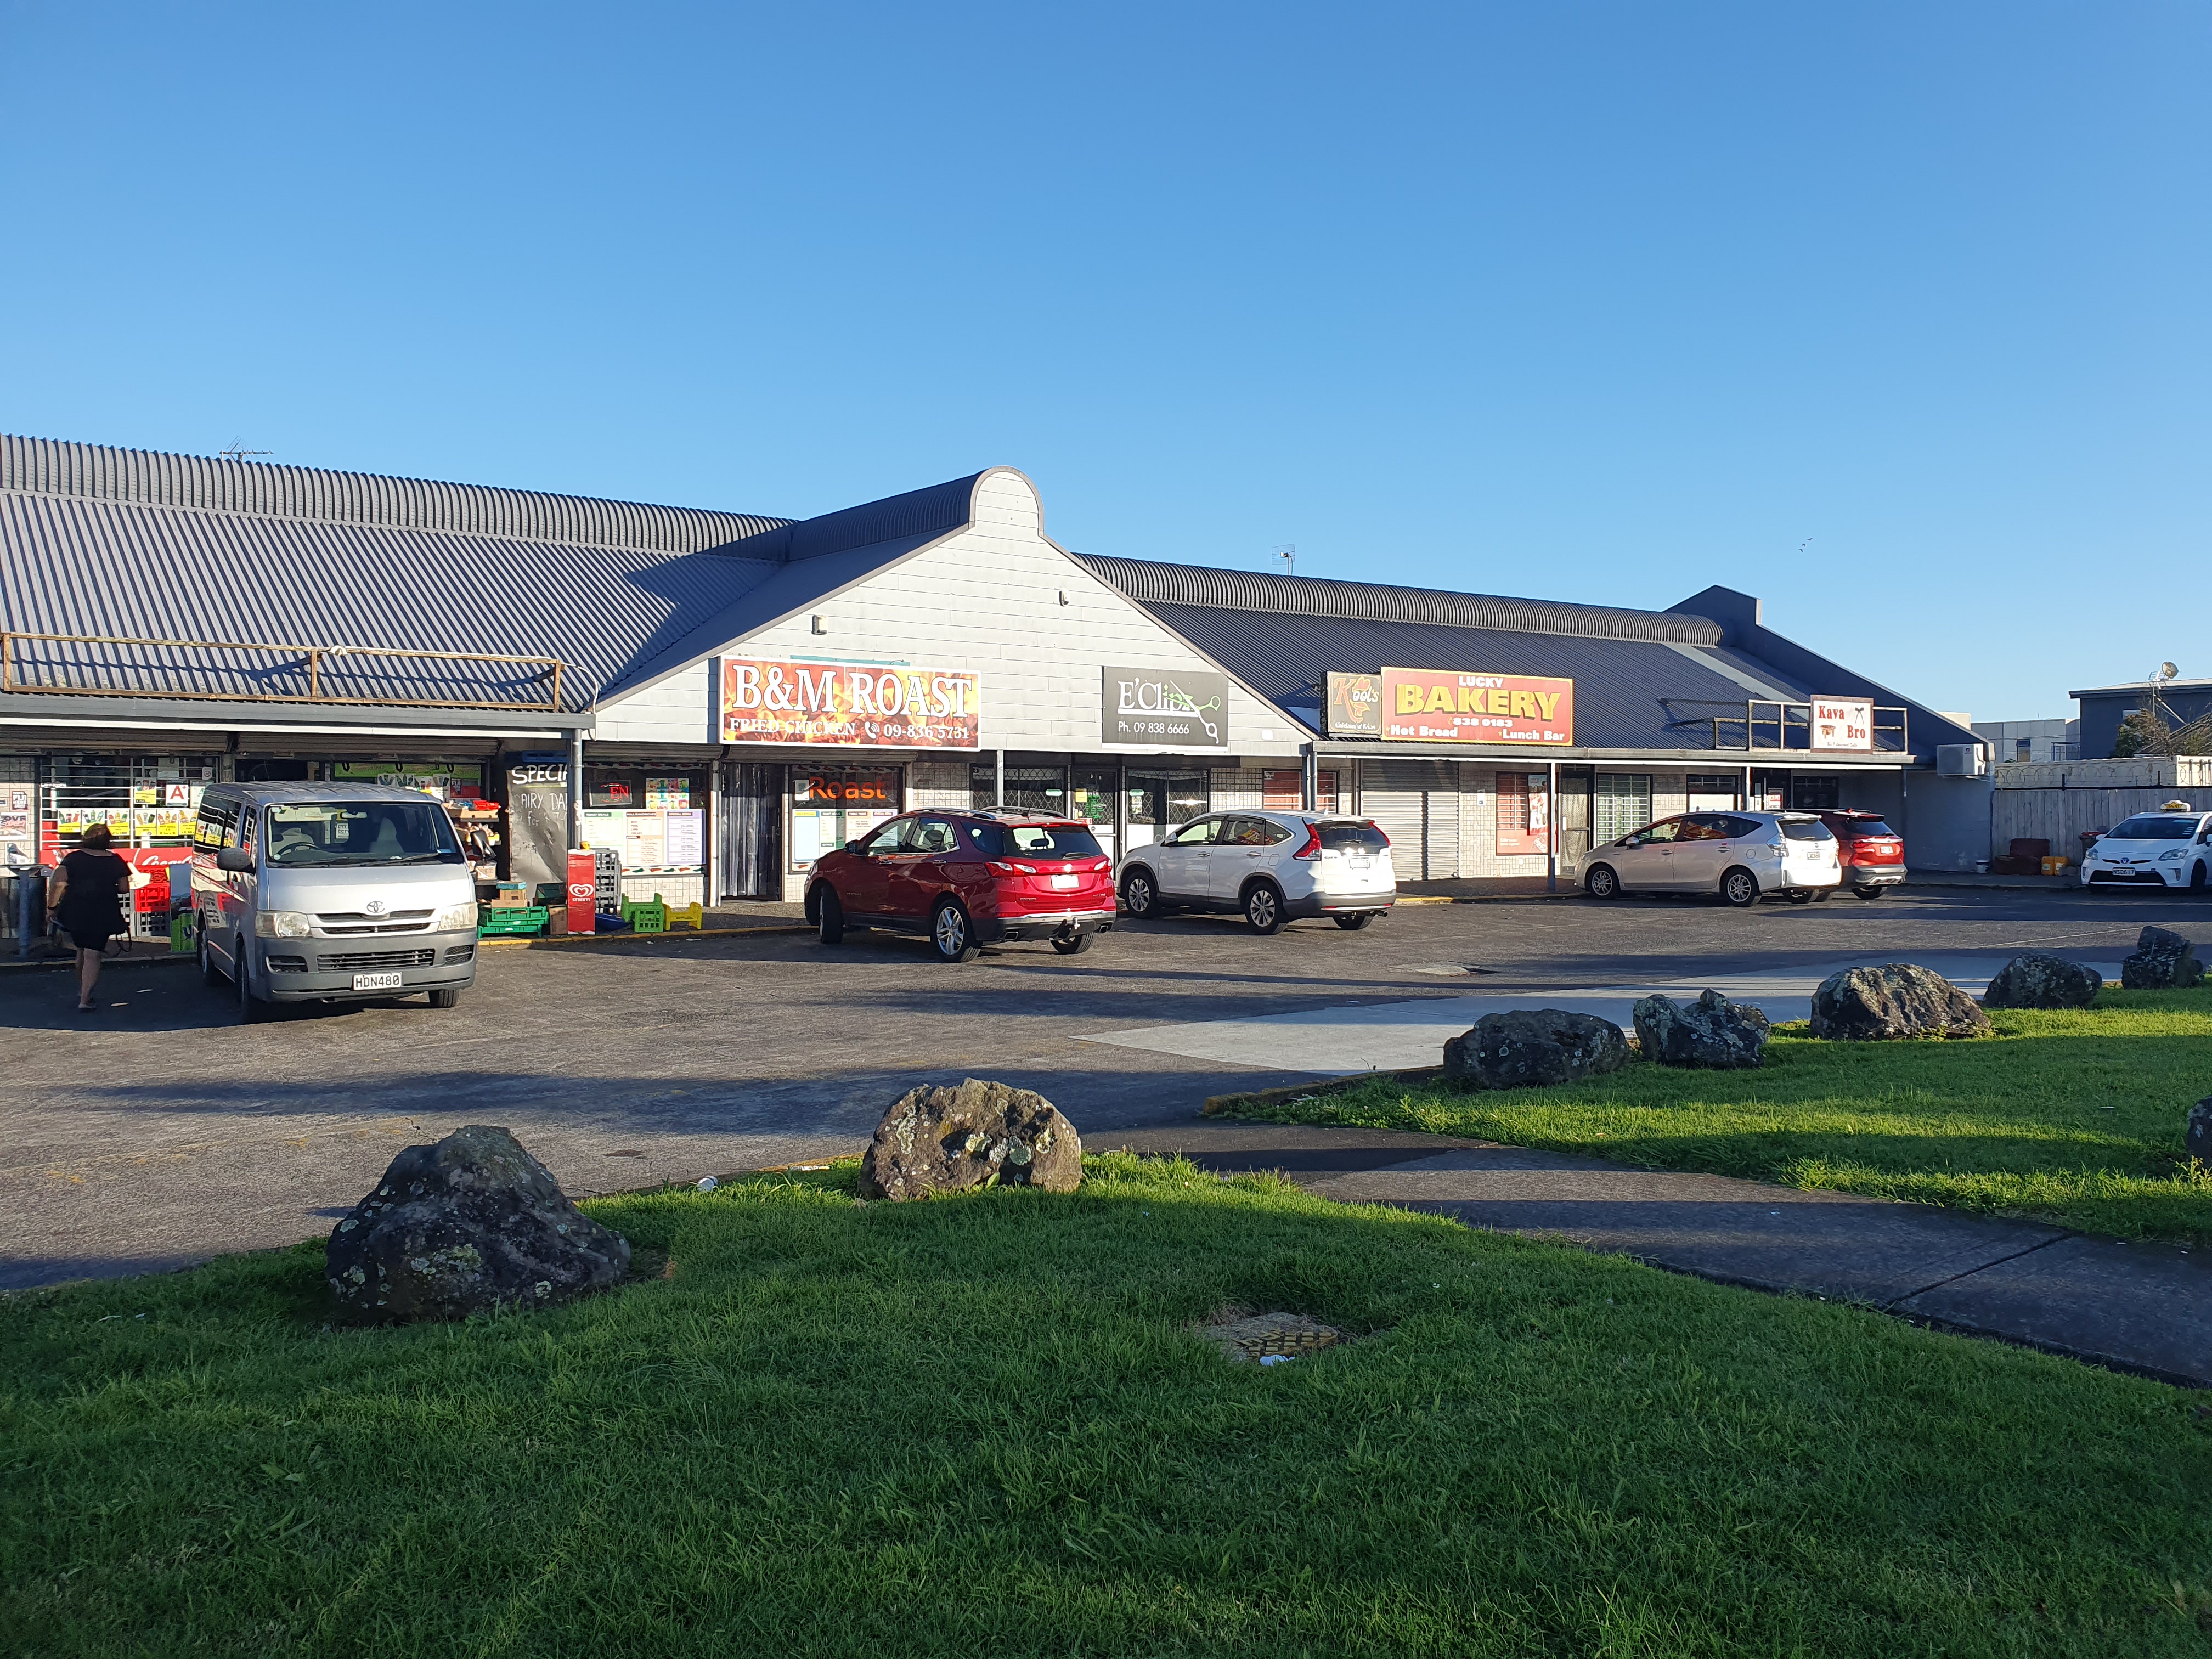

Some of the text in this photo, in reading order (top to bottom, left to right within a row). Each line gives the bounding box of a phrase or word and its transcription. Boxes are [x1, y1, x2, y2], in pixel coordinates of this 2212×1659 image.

[1459, 675, 1504, 688] LUCKY
[732, 664, 973, 718] B&M ROAST
[1333, 678, 1379, 723] Kool's
[1395, 684, 1561, 721] BAKERY
[1819, 705, 1844, 719] Kava
[730, 718, 856, 736] FRIED CHICKEN
[1118, 721, 1189, 734] Ph. 09 838 6666
[1453, 717, 1513, 727] 838 0183
[884, 724, 969, 739] 09-836 5731
[1390, 724, 1565, 741] Hot Bread Lunch Bar
[1847, 725, 1865, 738] Bro
[809, 776, 886, 799] Roast
[356, 975, 400, 988] HDN480
